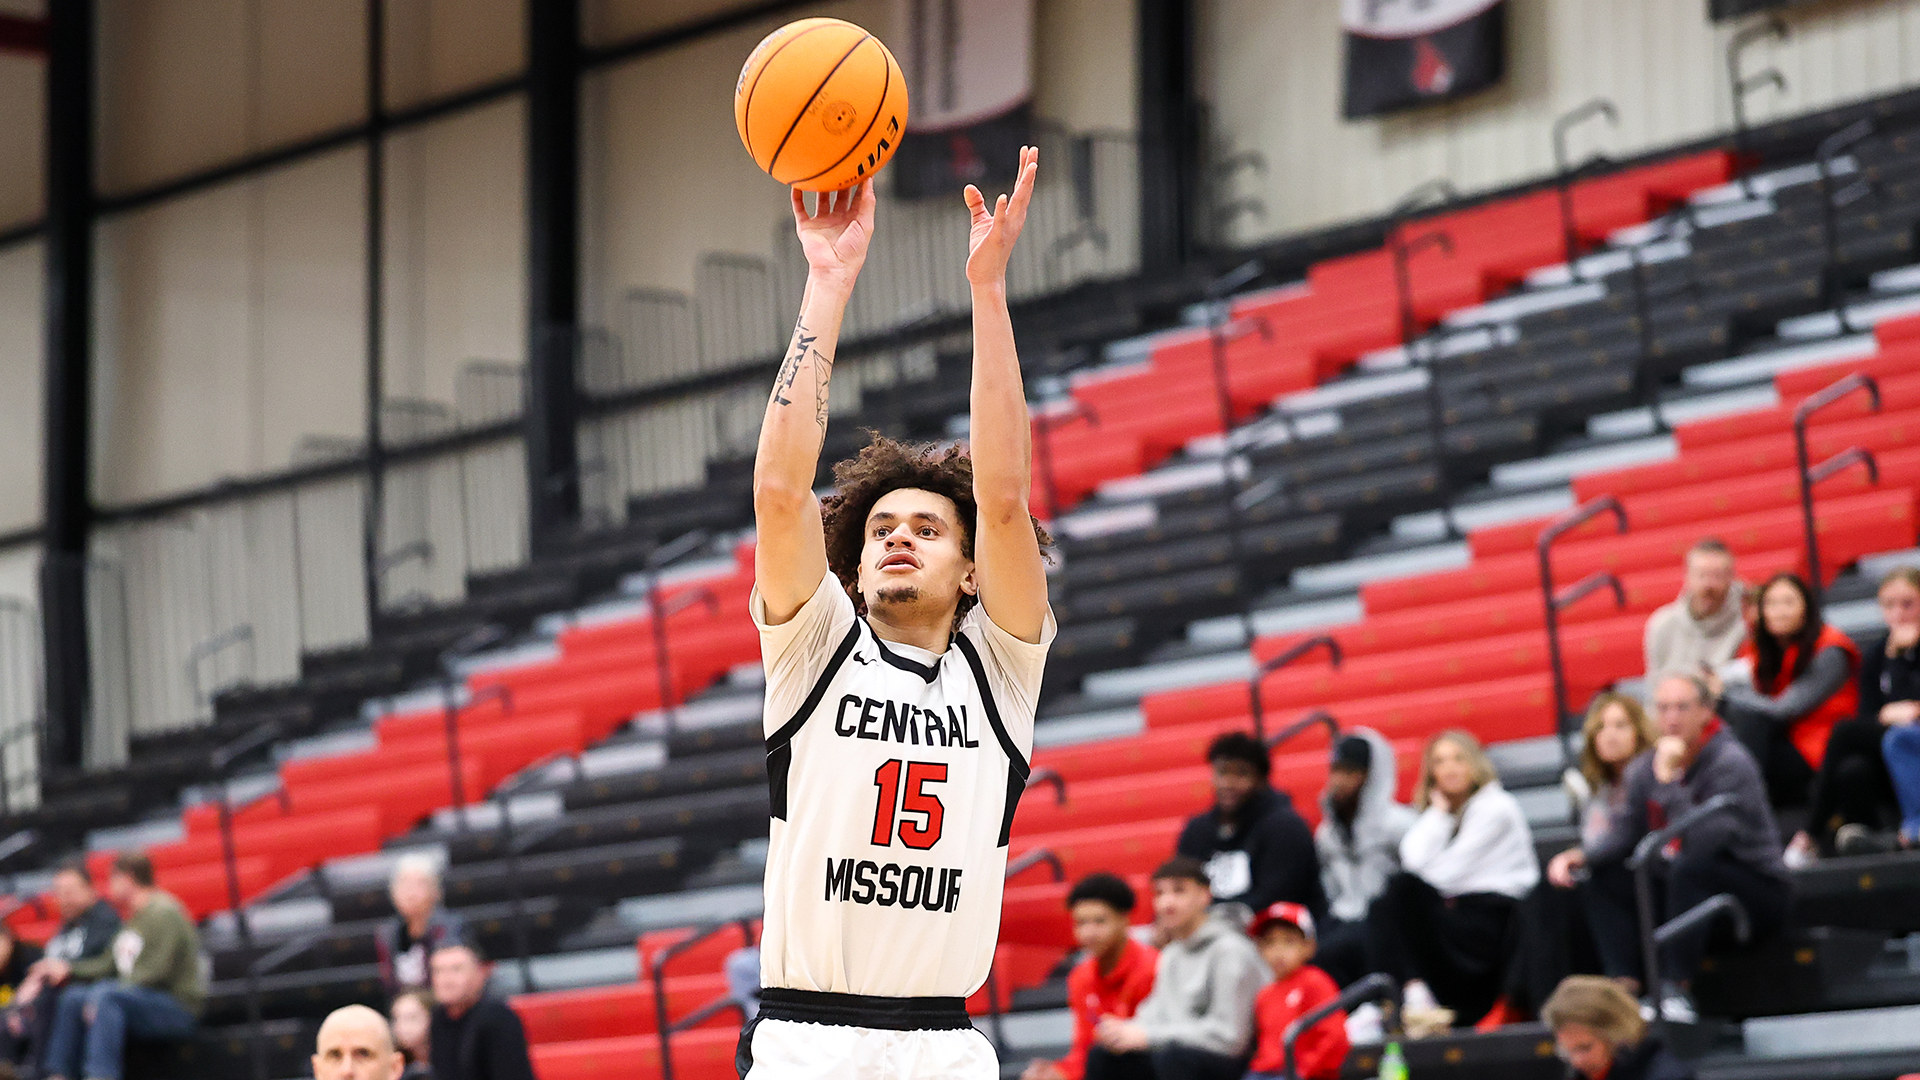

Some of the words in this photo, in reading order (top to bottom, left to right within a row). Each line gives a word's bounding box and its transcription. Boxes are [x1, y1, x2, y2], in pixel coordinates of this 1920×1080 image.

[834, 693, 979, 748] CENTRAL
[870, 758, 948, 850] 15
[825, 857, 963, 913] MISSOUR
